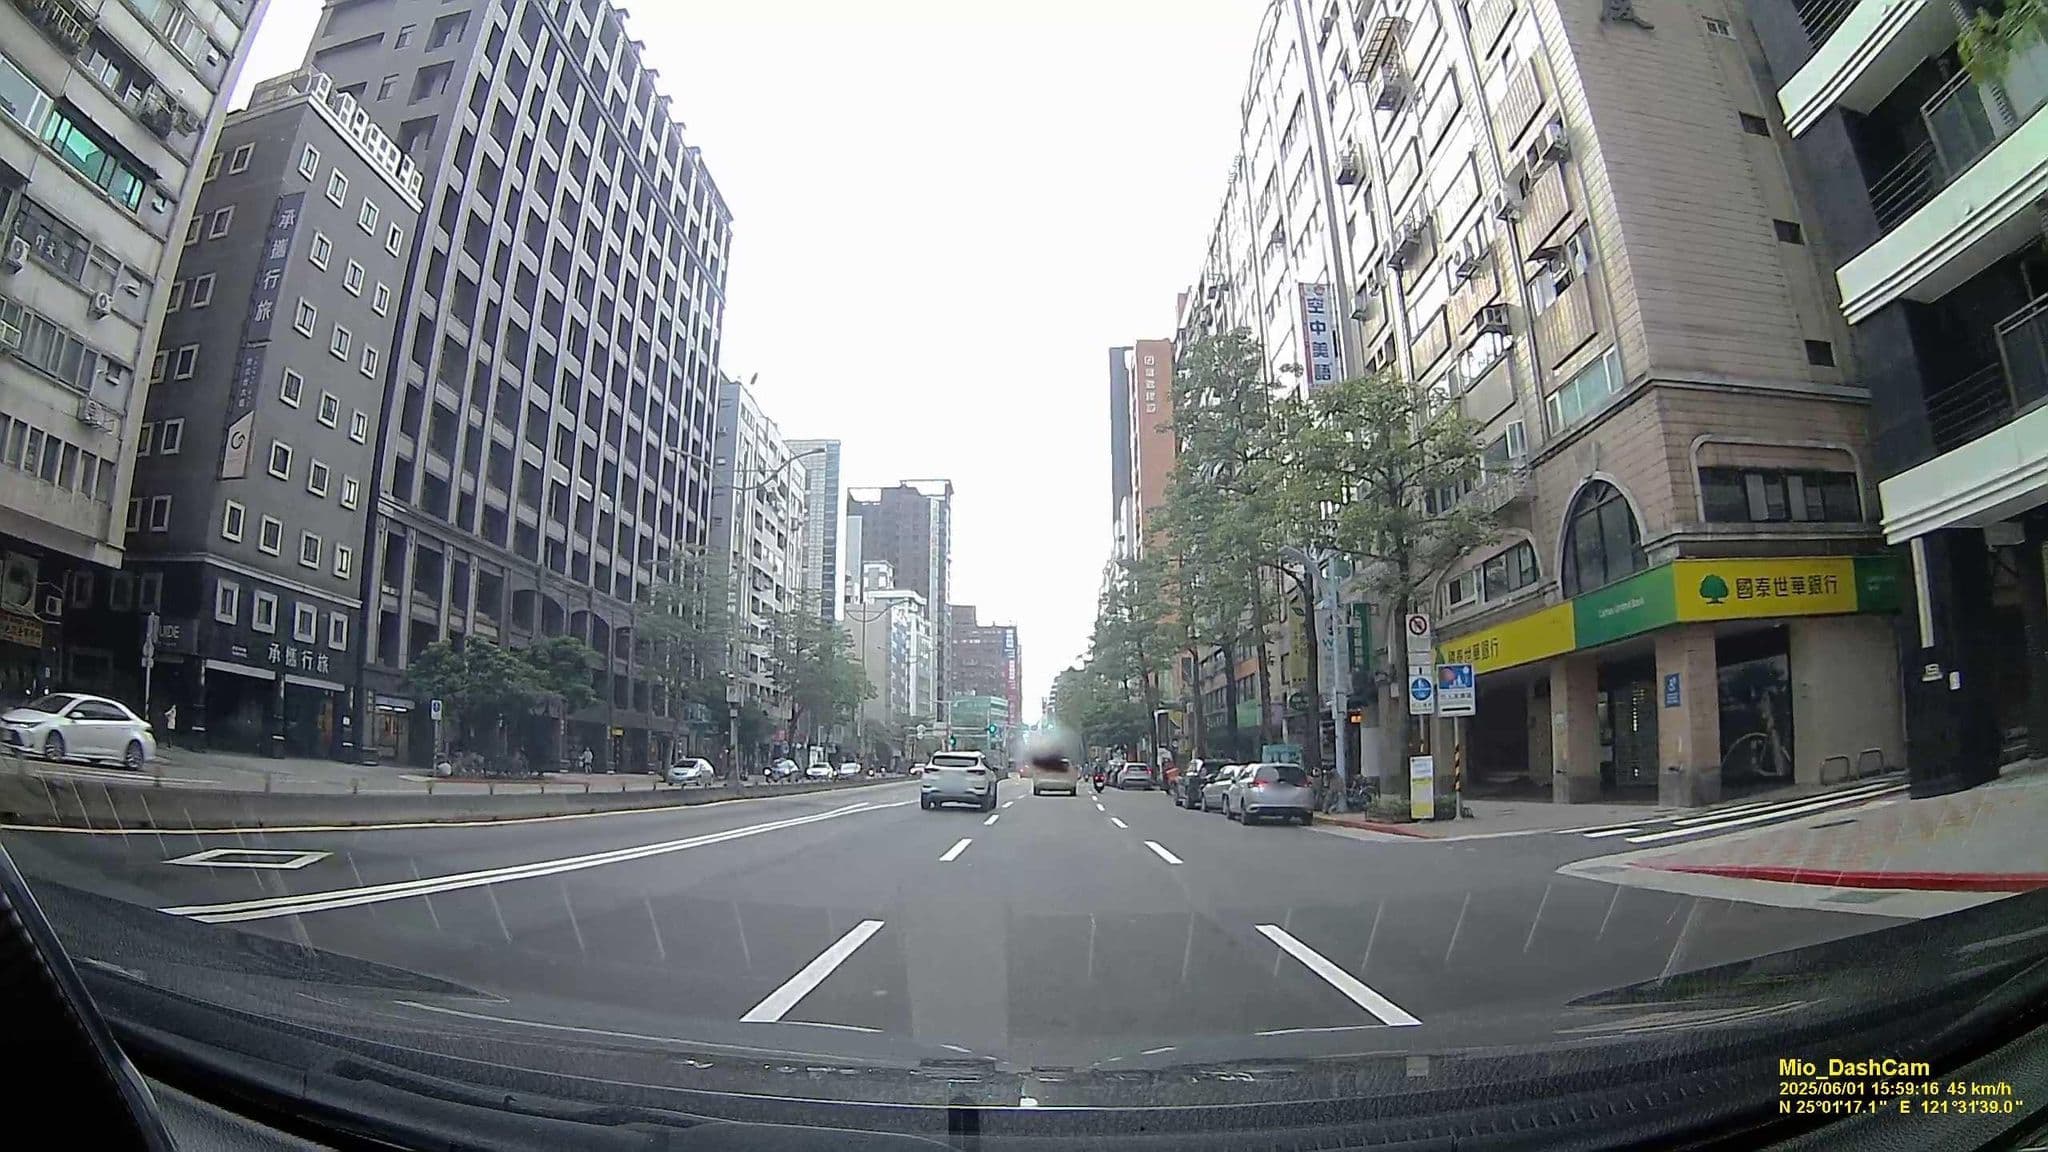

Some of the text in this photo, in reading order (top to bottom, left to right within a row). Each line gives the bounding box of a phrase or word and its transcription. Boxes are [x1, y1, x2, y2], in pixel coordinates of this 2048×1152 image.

[1307, 297, 1331, 381] 空中美語
[1735, 574, 1838, 600] 國泰世華銀行
[159, 624, 180, 639] UIDE
